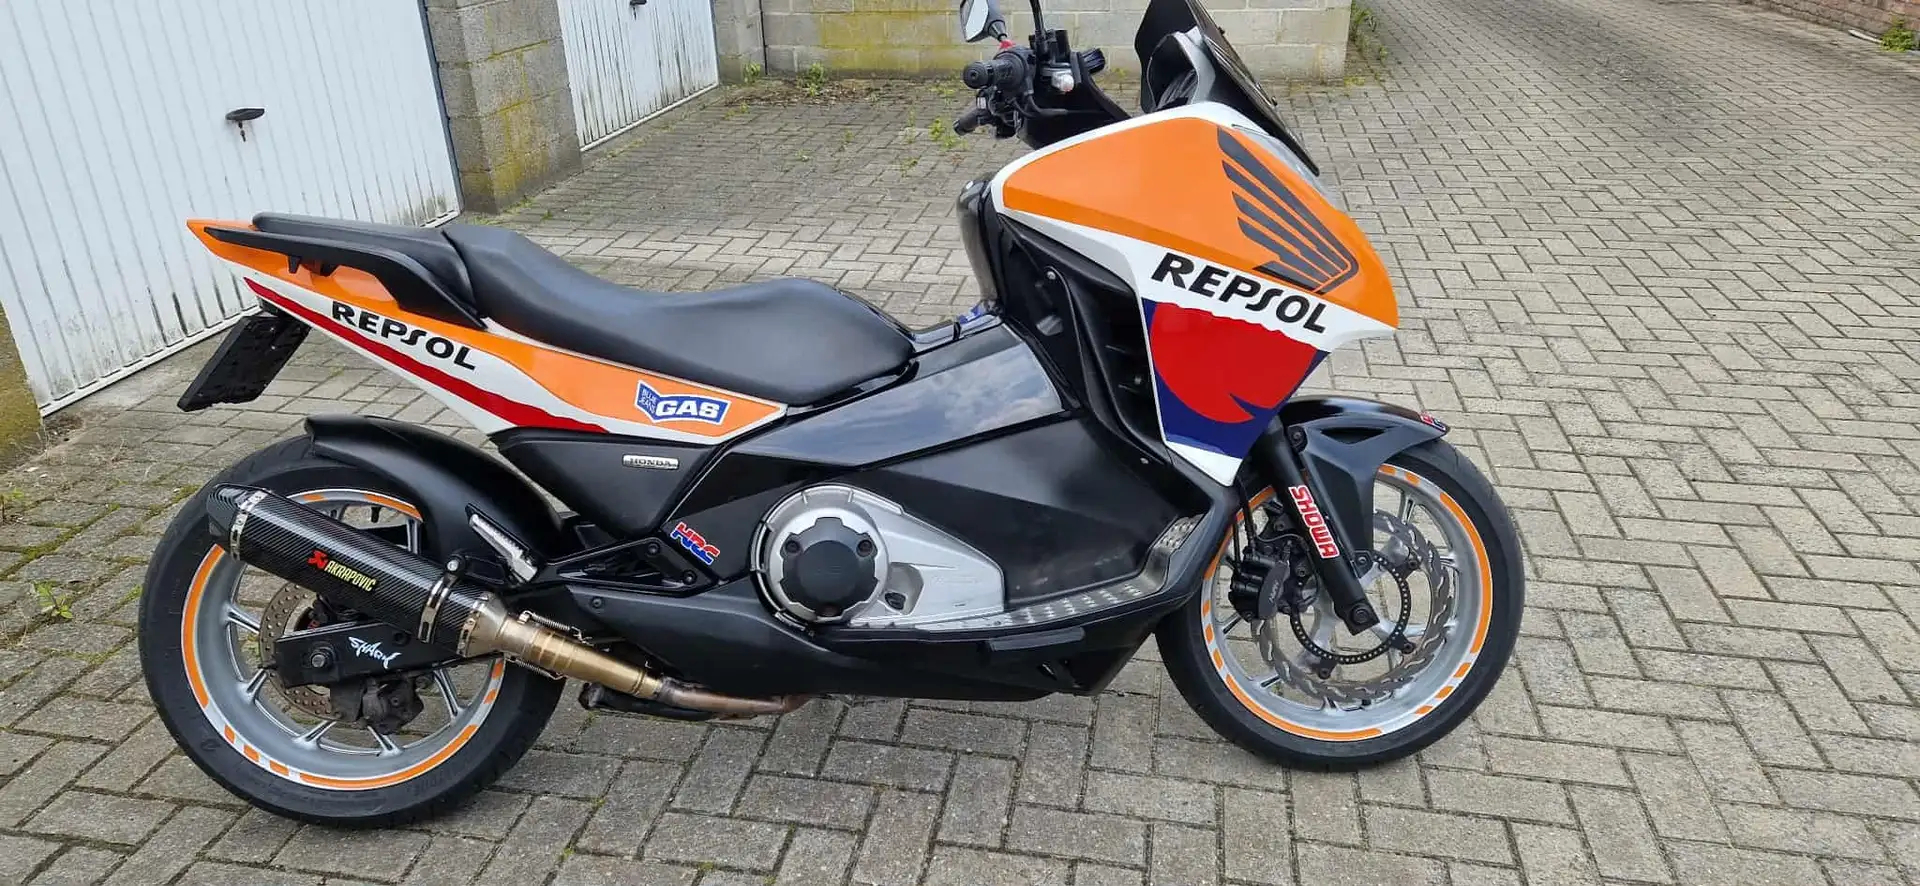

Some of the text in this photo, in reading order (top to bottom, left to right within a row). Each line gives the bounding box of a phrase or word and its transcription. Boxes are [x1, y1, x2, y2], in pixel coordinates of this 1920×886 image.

[1151, 252, 1326, 334] REPSOL
[332, 300, 476, 371] REPSOL
[655, 400, 720, 418] GAS
[630, 458, 671, 468] HONDA
[670, 521, 720, 565] HRC
[1288, 485, 1340, 558] SHOWA
